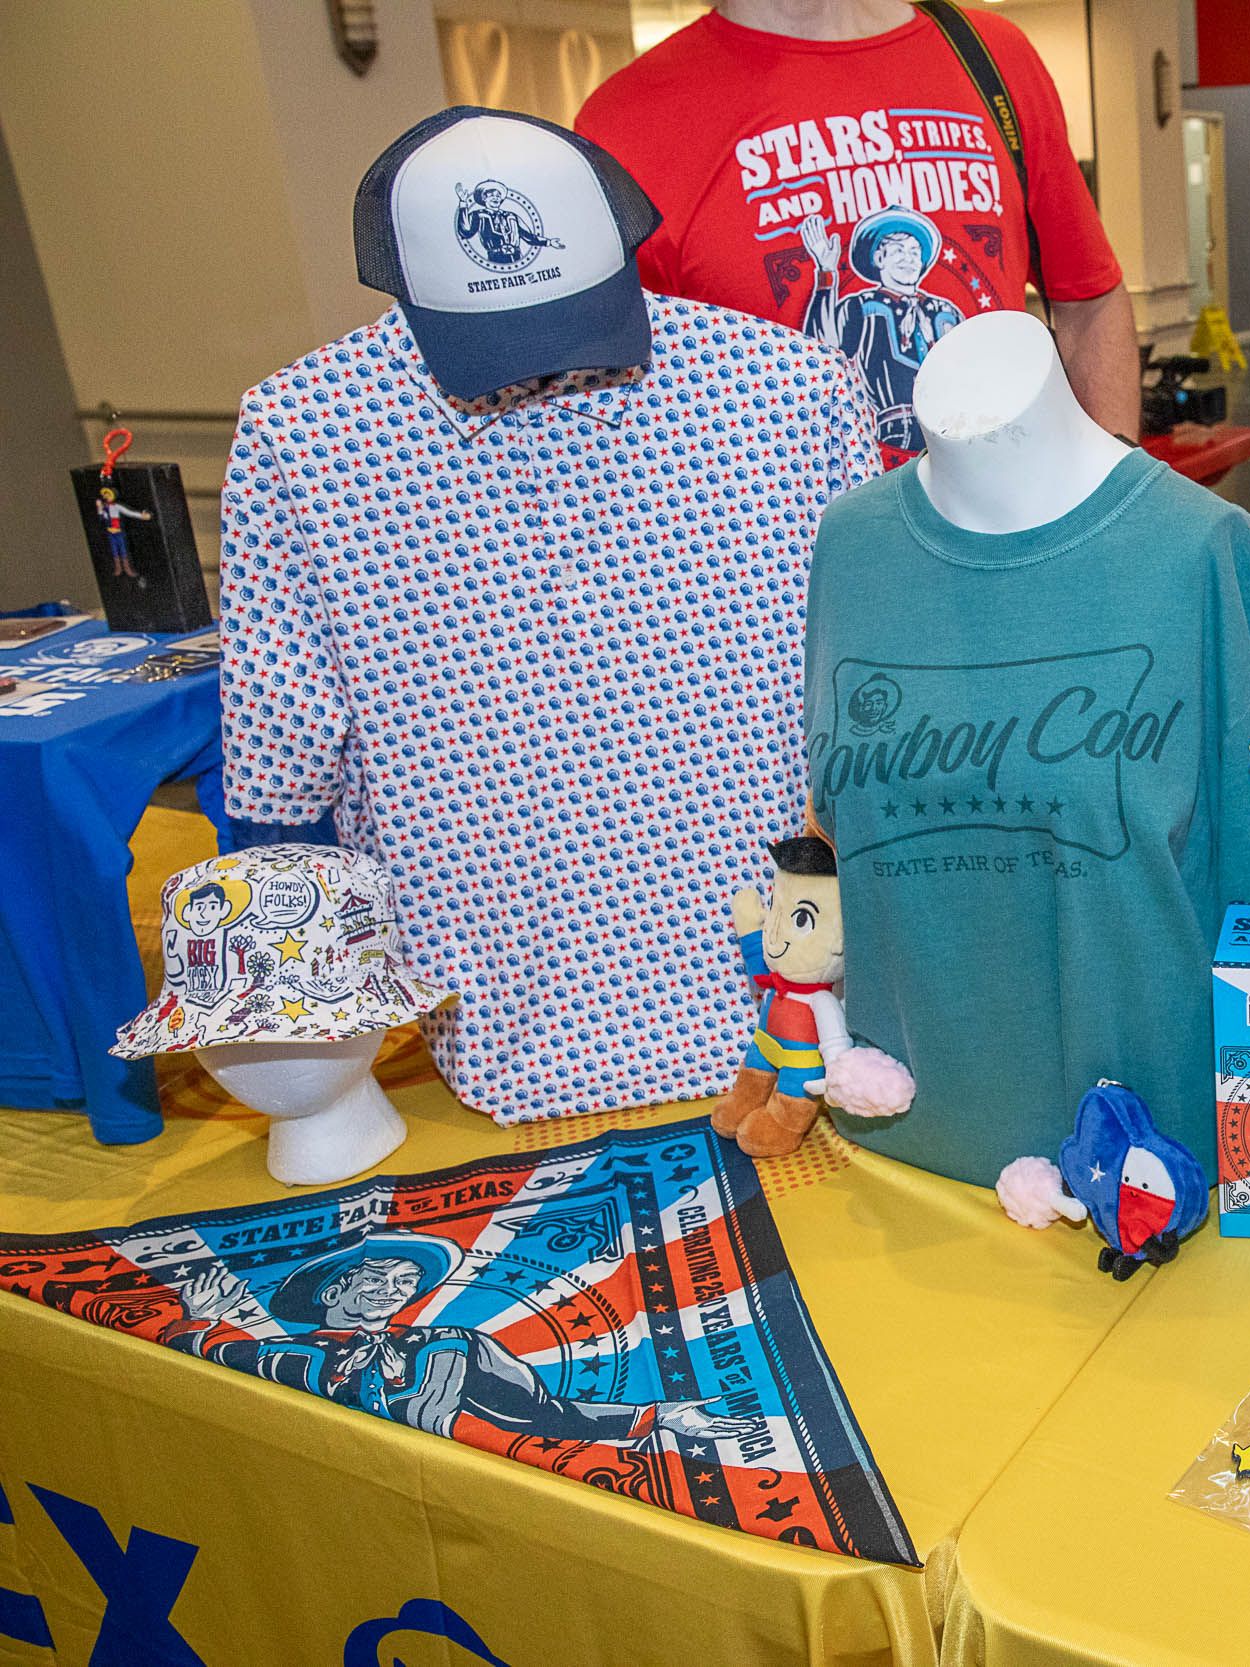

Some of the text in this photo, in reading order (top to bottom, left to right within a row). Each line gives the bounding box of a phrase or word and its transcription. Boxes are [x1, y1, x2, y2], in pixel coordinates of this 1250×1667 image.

[735, 109, 904, 190] STARS,
[758, 161, 1004, 227] AND HOWDIES!
[467, 280, 500, 293] STATE
[501, 275, 526, 288] FAIR
[537, 267, 561, 281] TEXAS
[1027, 686, 1184, 764] Cool
[873, 858, 938, 877] STATE
[943, 855, 990, 872] FAIR
[994, 856, 1019, 873] OF
[269, 881, 305, 893] HOWDY
[263, 894, 307, 908] FOLKS!
[187, 939, 216, 966] BIG
[187, 965, 219, 992] TEX
[219, 1215, 325, 1249] STATE
[330, 1197, 399, 1230] FAIR
[410, 1200, 433, 1213] OF
[677, 1205, 722, 1283] CELEBRATING
[693, 1281, 728, 1308] 250
[700, 1303, 746, 1370] YEARS
[724, 1373, 747, 1385] OF
